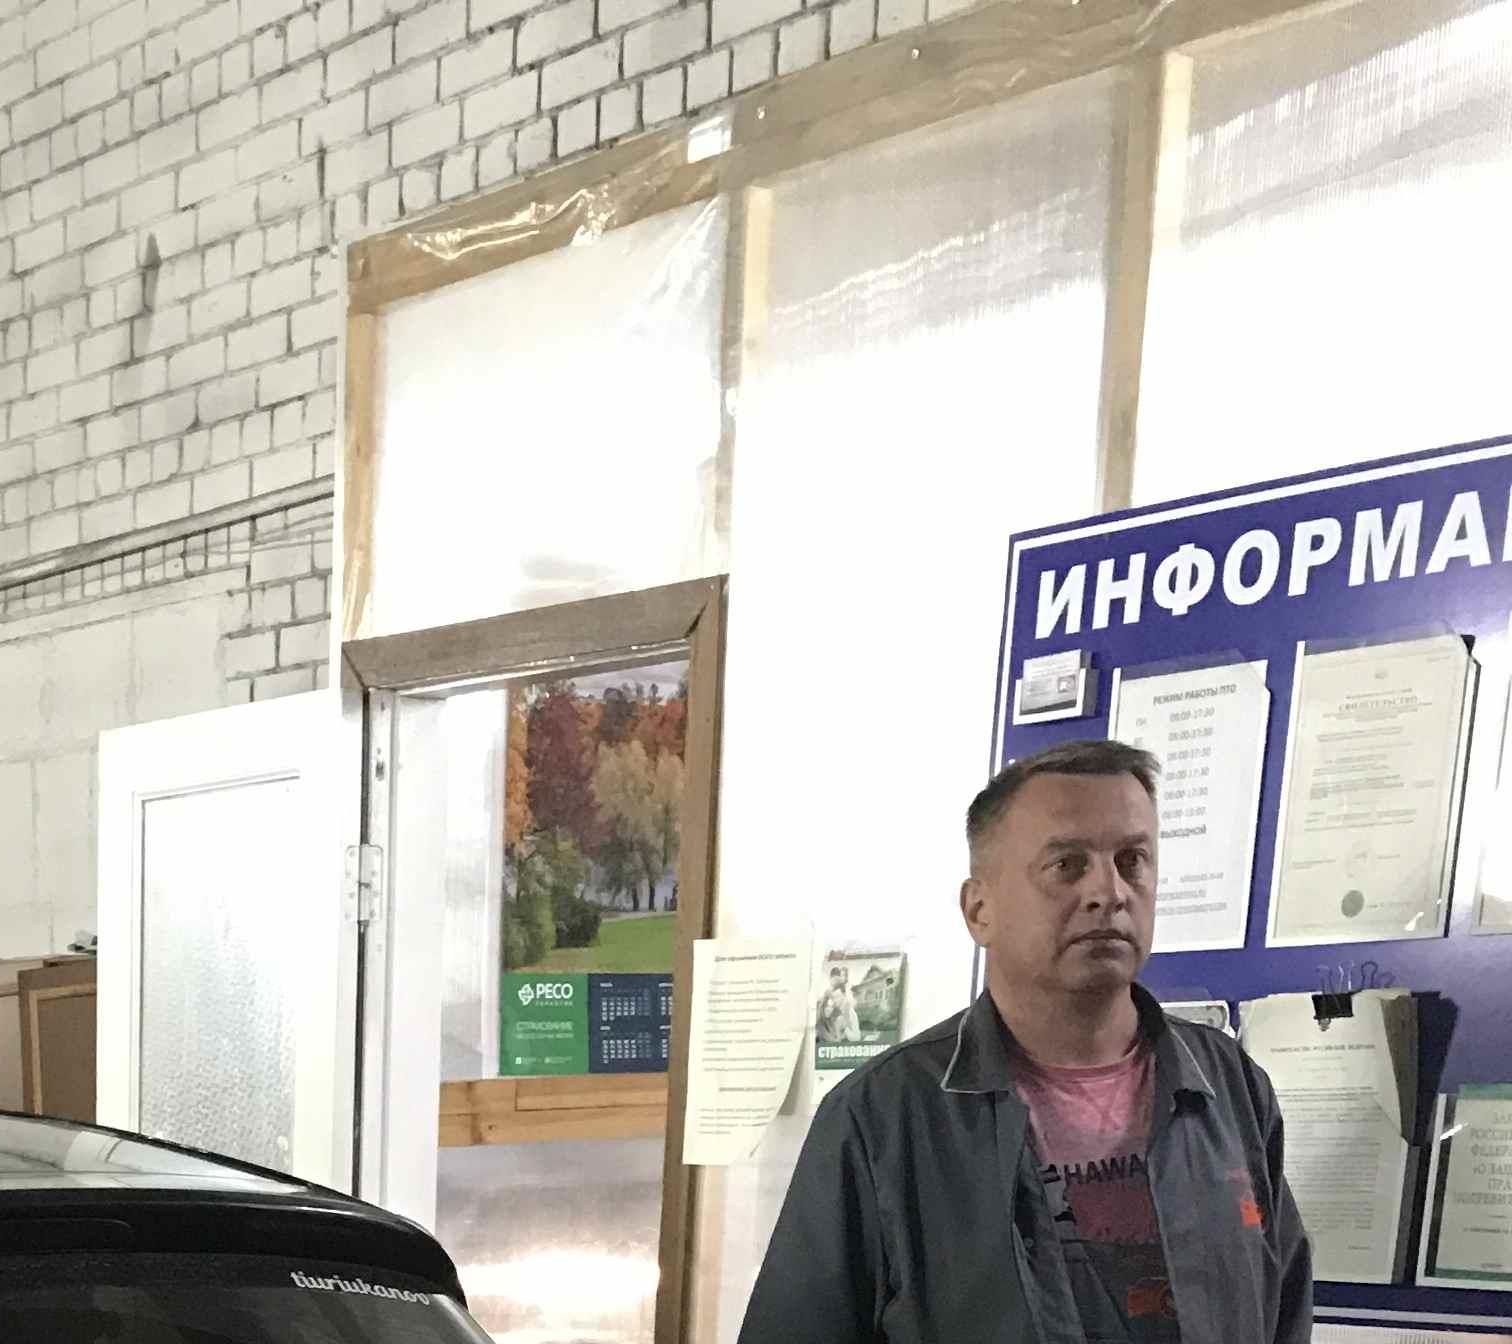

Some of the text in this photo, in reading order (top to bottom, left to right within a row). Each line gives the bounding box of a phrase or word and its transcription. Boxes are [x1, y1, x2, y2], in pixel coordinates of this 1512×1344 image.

[1035, 484, 1512, 639] ИНФОРМА
[536, 983, 574, 999] РЕСО
[818, 1044, 890, 1059] страховани
